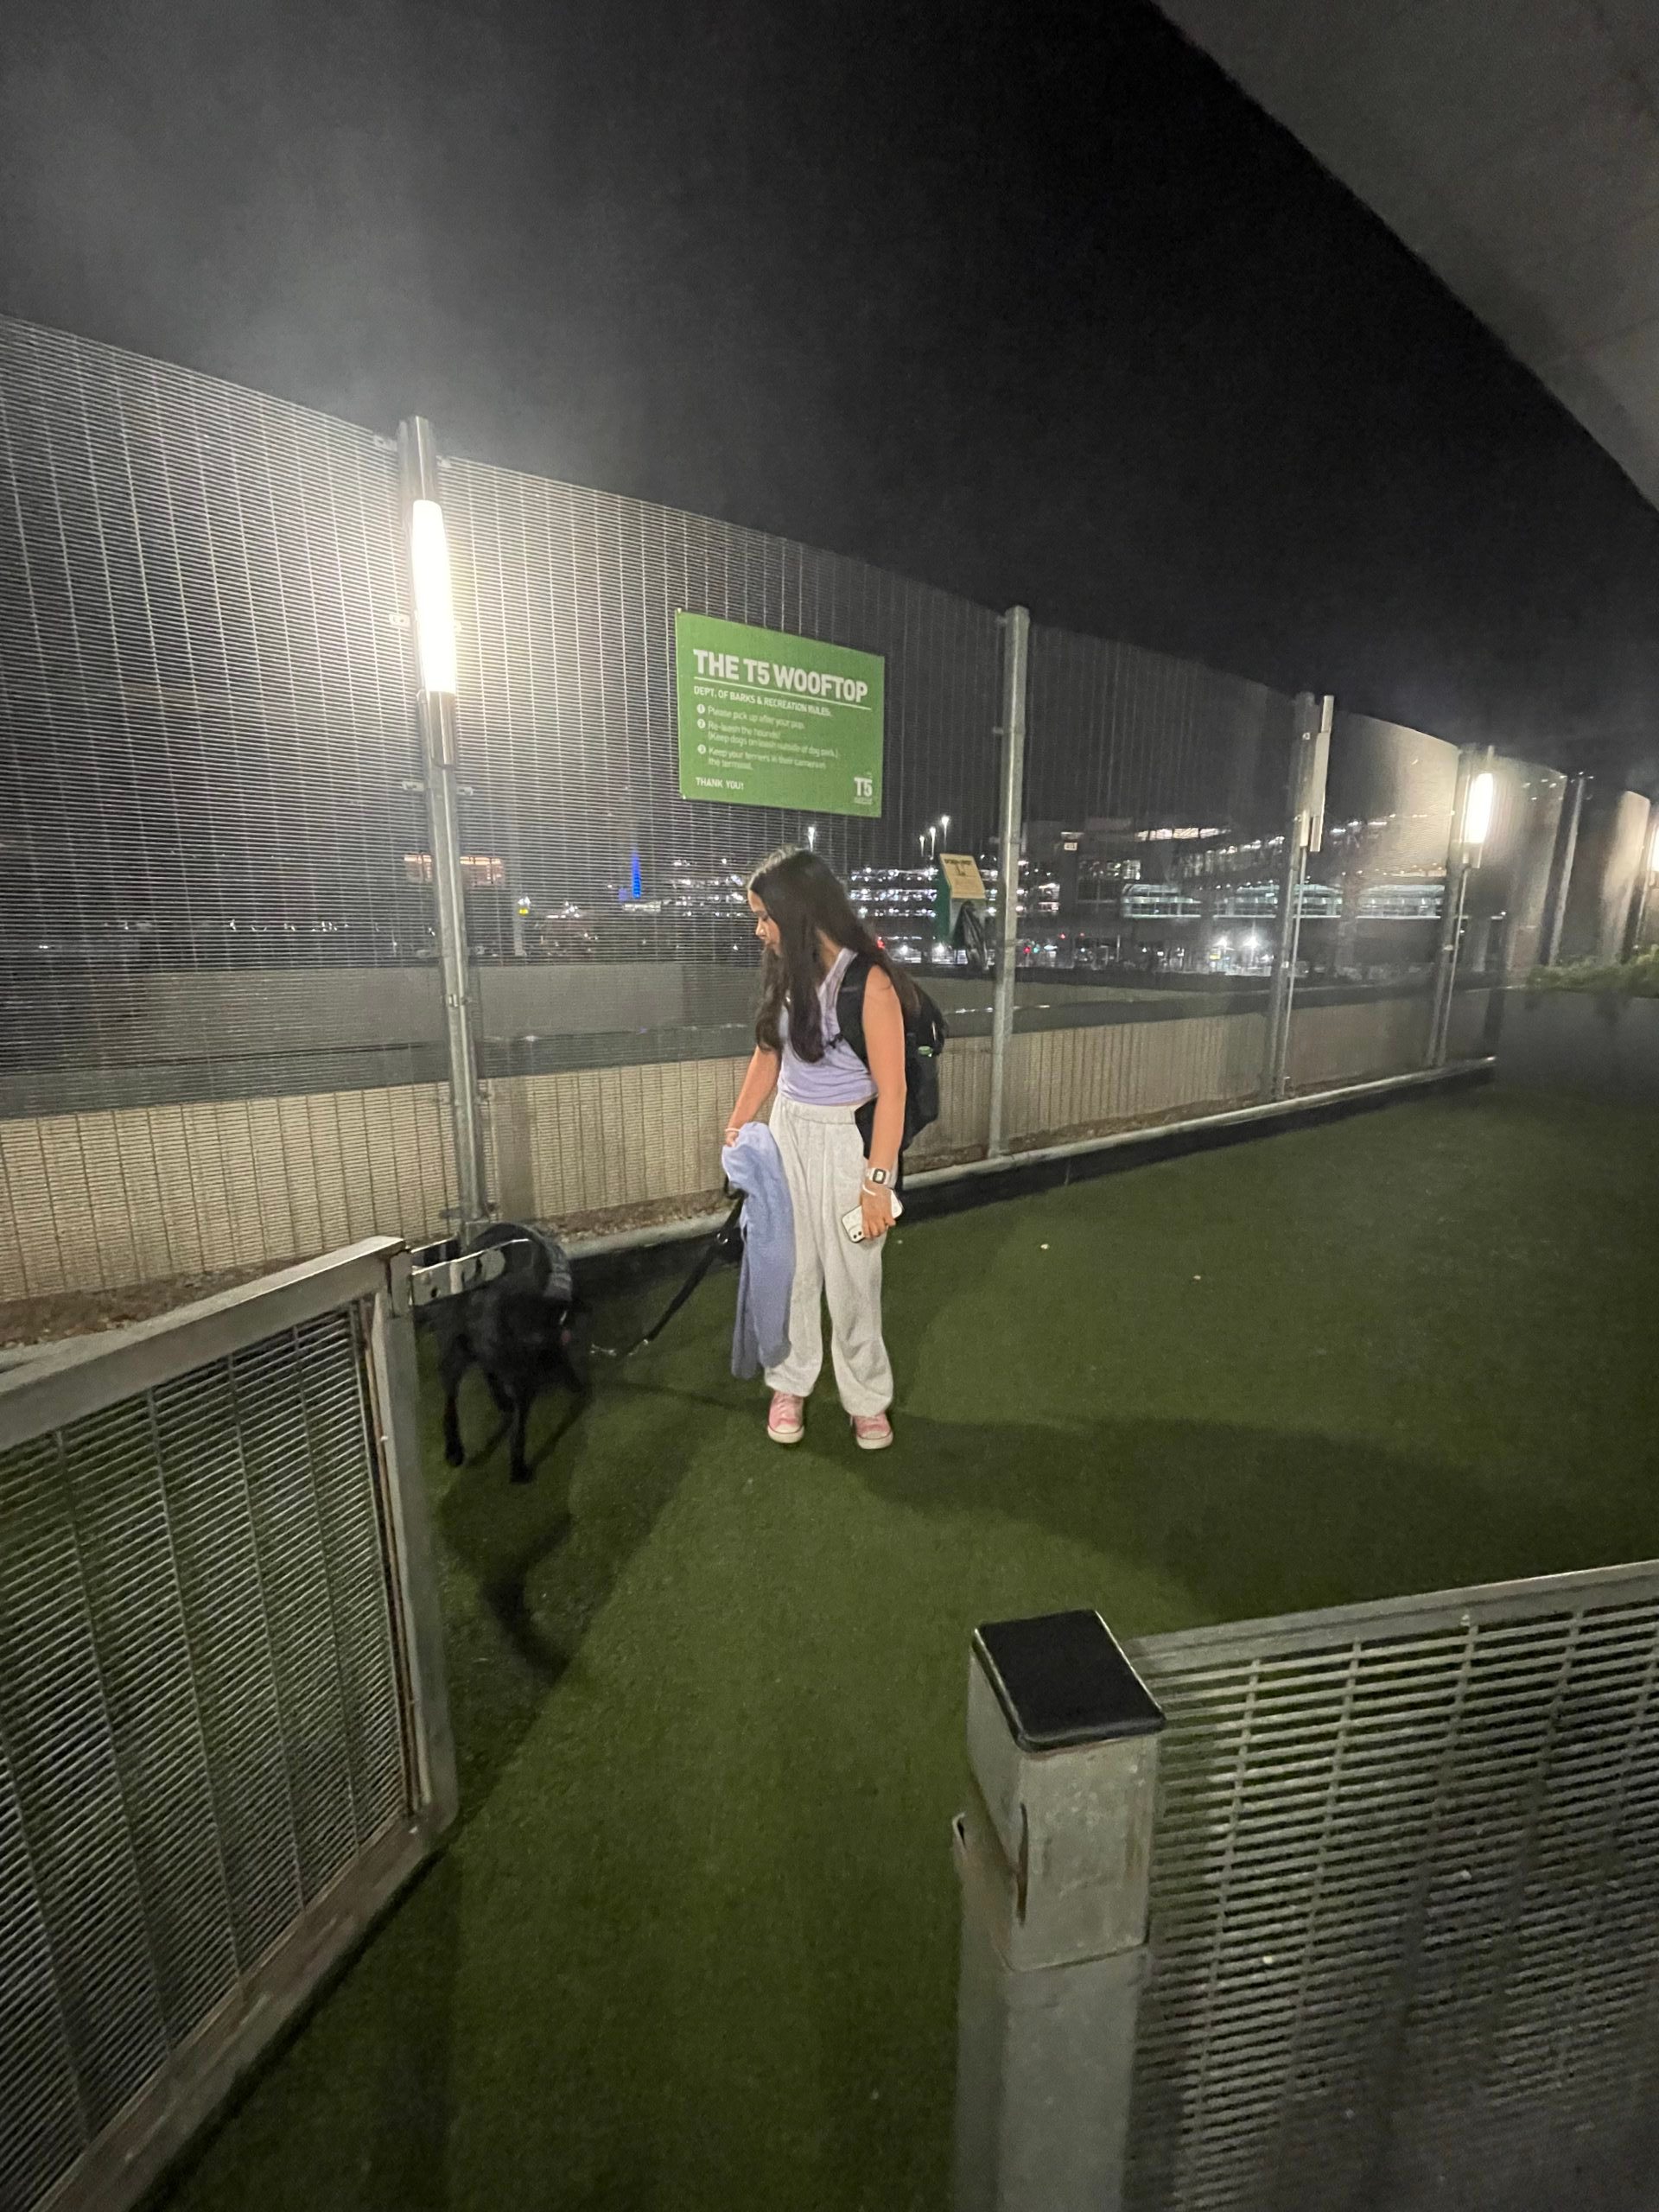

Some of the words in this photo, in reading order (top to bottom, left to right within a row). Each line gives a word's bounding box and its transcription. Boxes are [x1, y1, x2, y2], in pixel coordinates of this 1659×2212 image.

[693, 649, 739, 681] THE
[743, 658, 770, 685] T5
[772, 664, 868, 702] WOOFTOP
[694, 685, 717, 698] DEPT.
[718, 690, 728, 699] OF
[729, 691, 756, 704] BARKS
[757, 696, 763, 705] &
[764, 697, 807, 713] RECREATION
[733, 710, 747, 721] pick
[749, 715, 758, 723] up
[696, 777, 723, 789] THANK
[854, 777, 873, 797] T5
